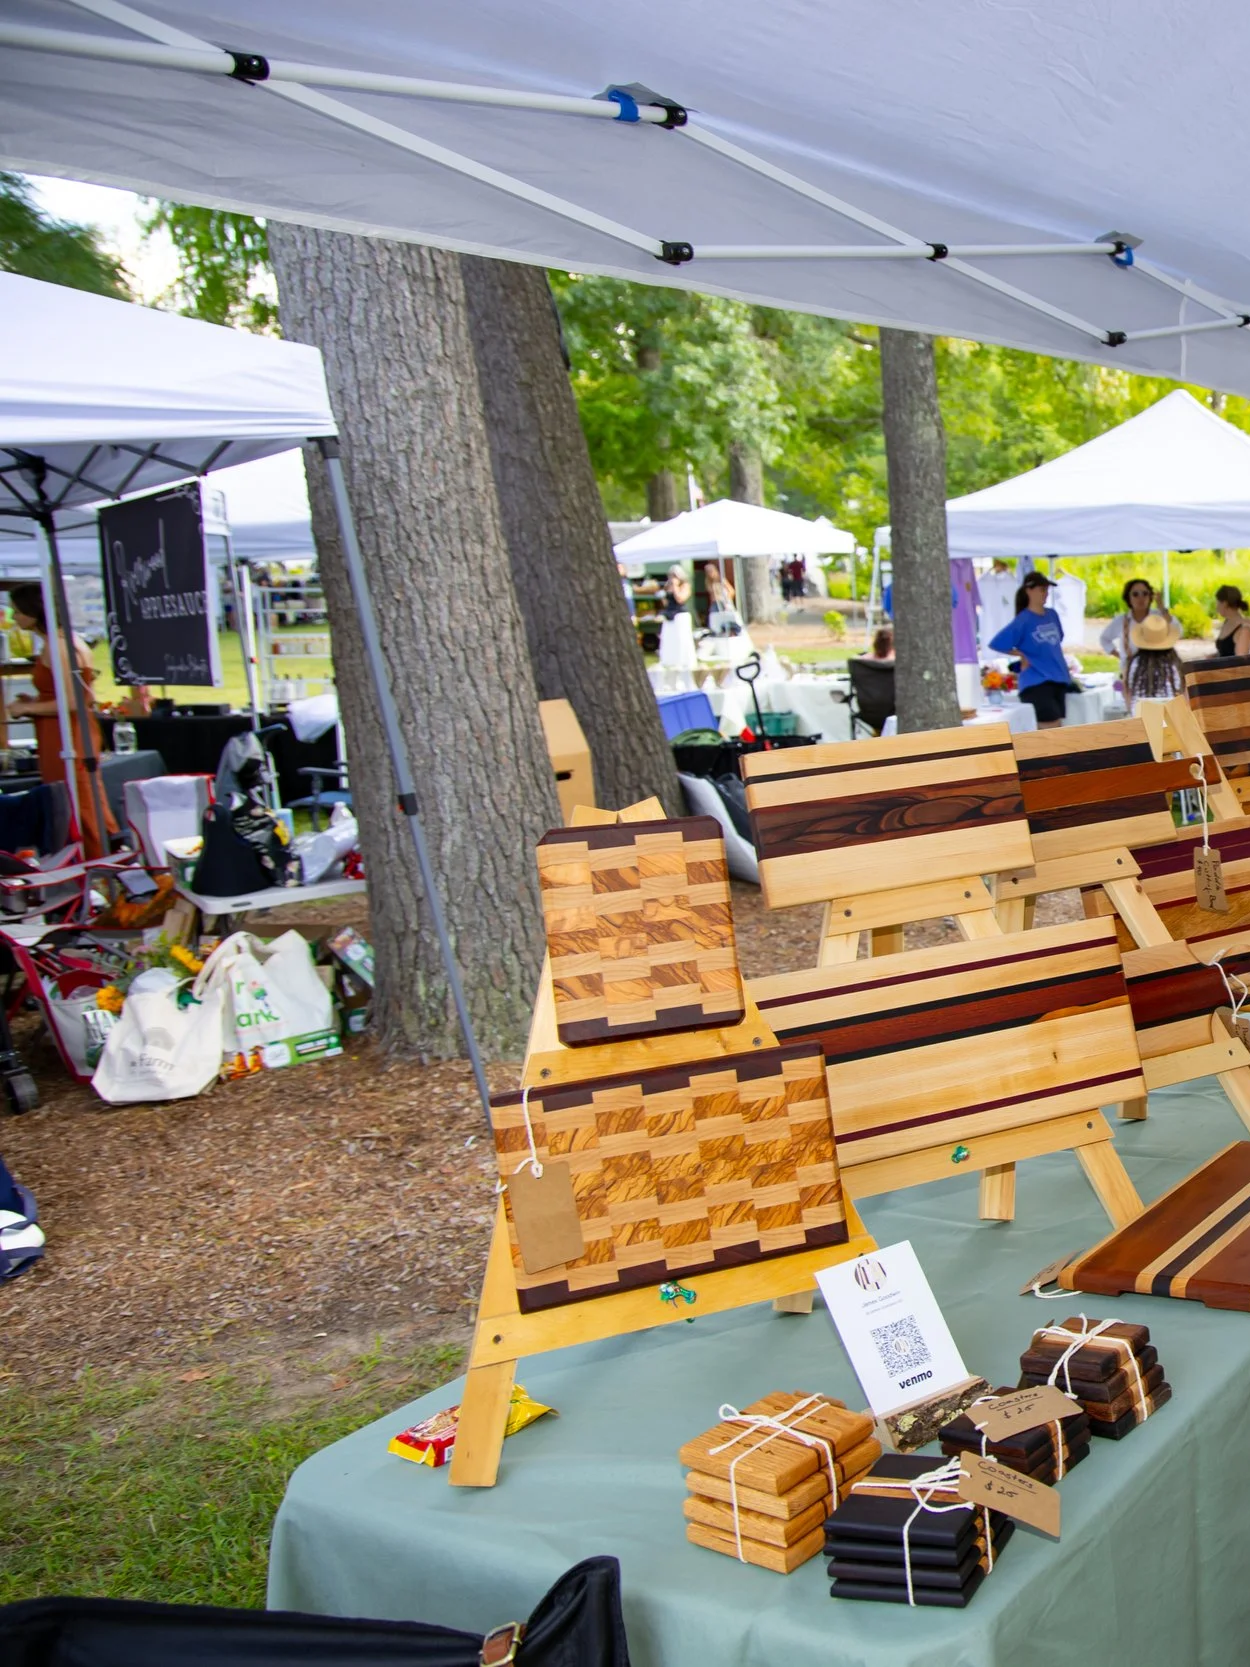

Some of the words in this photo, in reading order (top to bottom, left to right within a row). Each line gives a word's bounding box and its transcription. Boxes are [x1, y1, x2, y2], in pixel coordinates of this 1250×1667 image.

[898, 1370, 932, 1389] venmo
[988, 1392, 1038, 1410] Coasters
[978, 1461, 1033, 1489] Coasters
